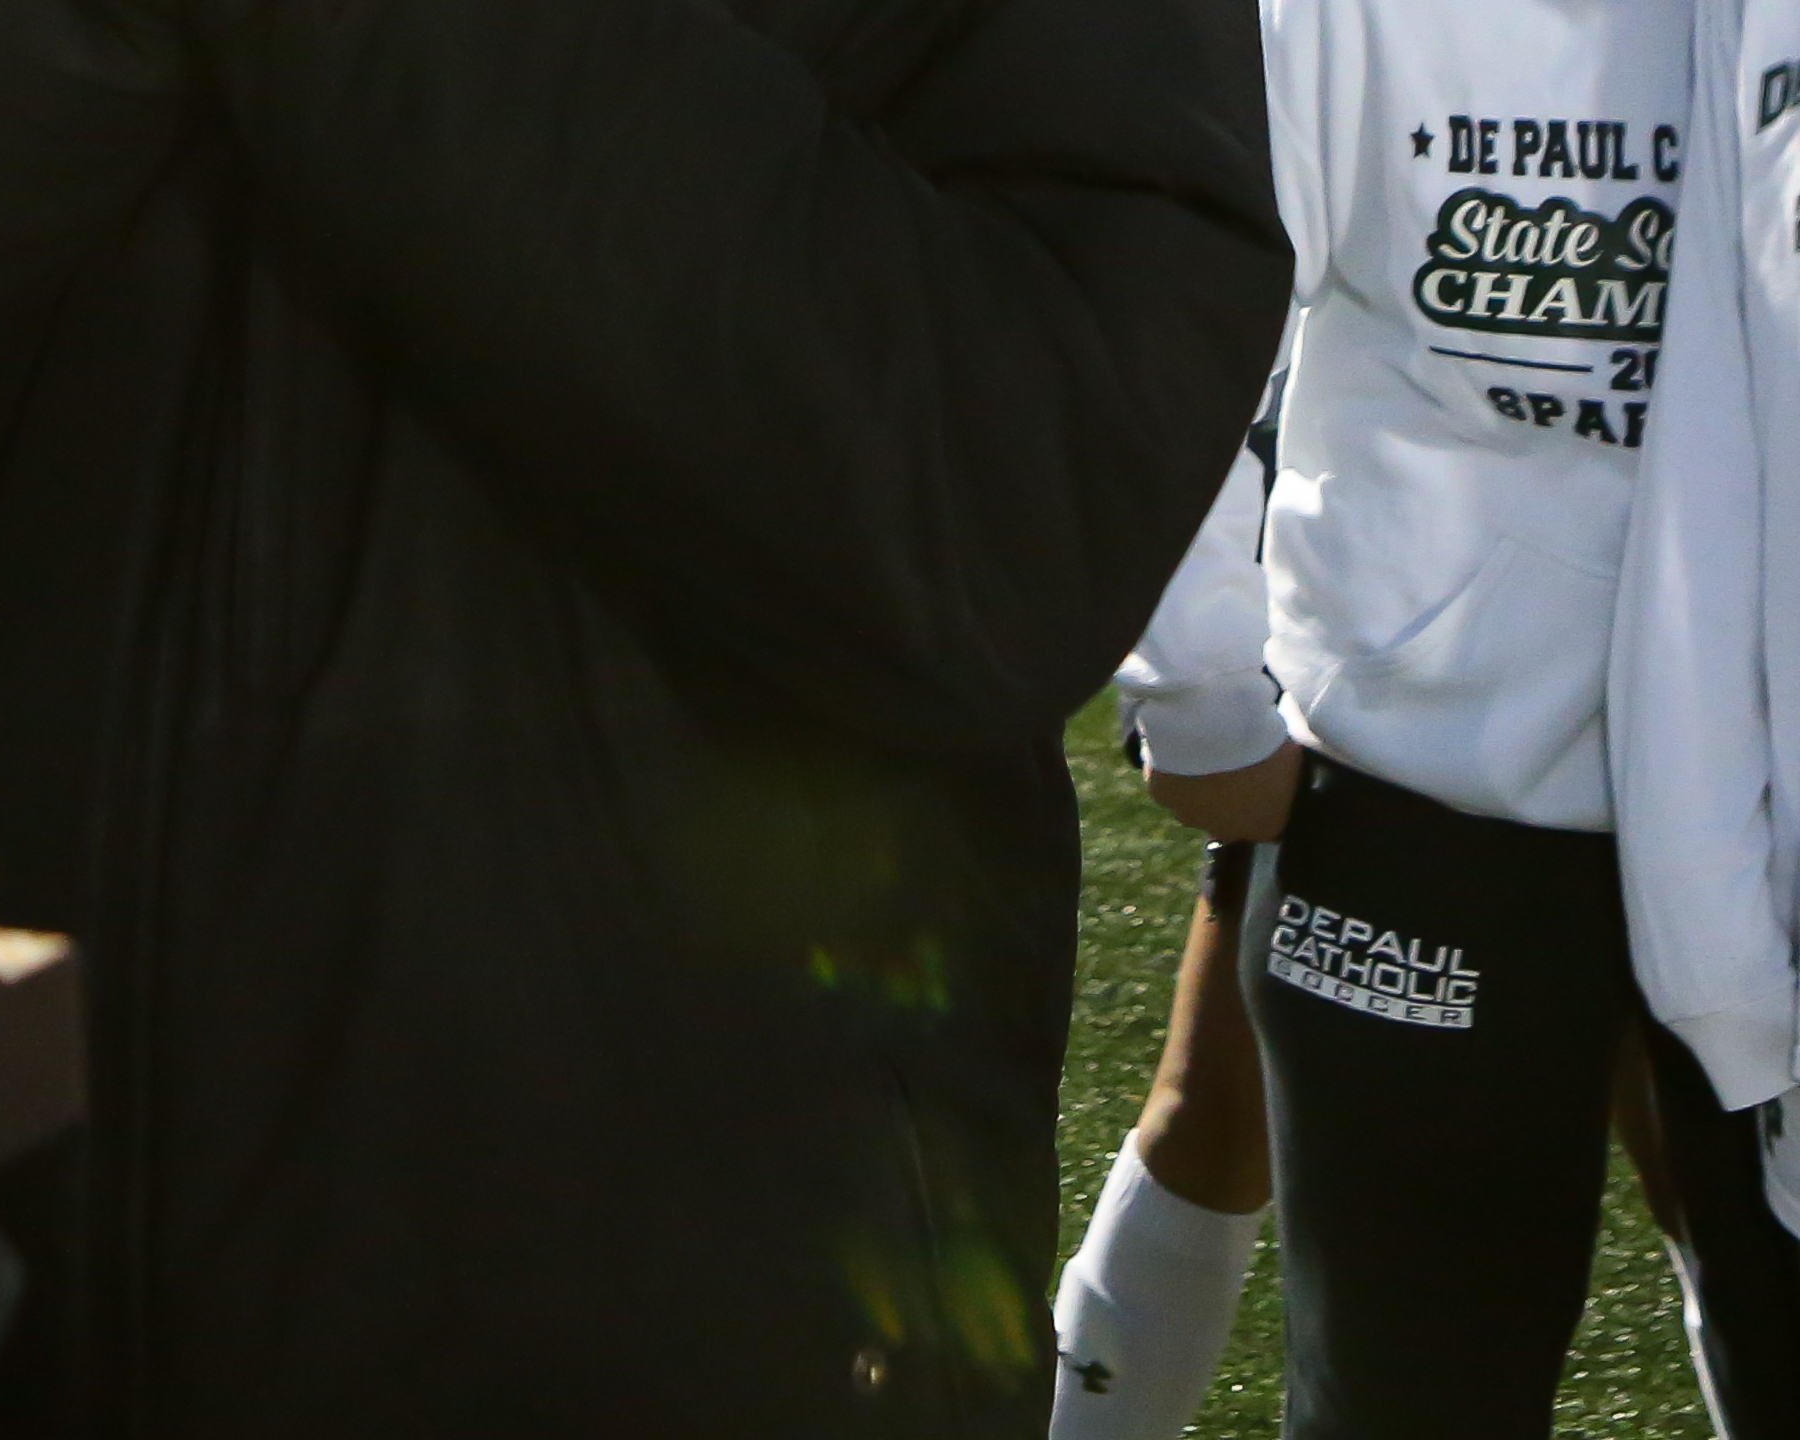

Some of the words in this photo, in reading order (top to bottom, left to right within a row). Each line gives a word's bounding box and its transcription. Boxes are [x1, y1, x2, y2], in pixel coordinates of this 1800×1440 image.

[1449, 115, 1501, 174] DE
[1512, 119, 1640, 180] PAUL
[1438, 198, 1605, 268] State
[1270, 924, 1478, 1005] CATHOLIC
[1278, 894, 1480, 979] DEPAUL
